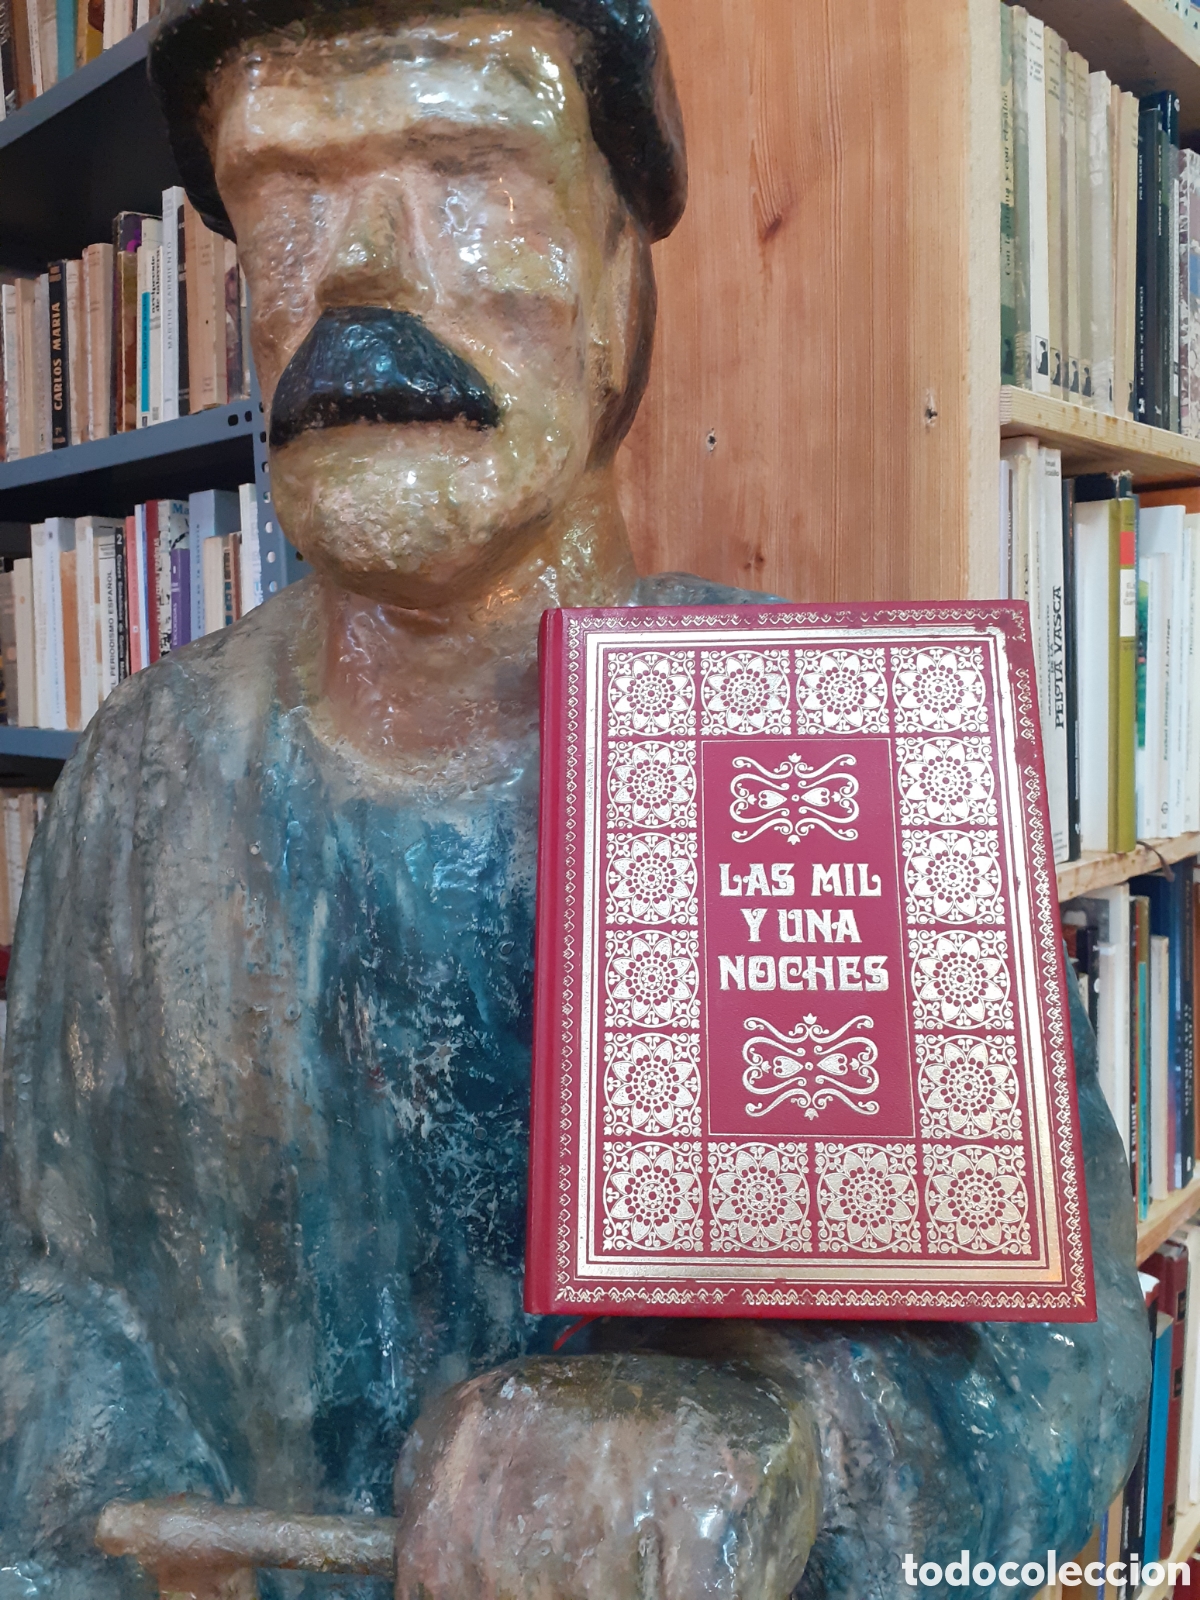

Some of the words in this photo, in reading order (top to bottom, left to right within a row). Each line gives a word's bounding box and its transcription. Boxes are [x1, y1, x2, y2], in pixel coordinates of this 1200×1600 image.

[51, 302, 62, 351] MARIA
[53, 358, 63, 411] CARLOS
[116, 533, 122, 545] 2
[109, 618, 117, 676] PERIODISMO
[1052, 585, 1063, 661] VASCA
[1054, 662, 1064, 730] PELOTA
[718, 863, 795, 897] LAS
[811, 863, 882, 897] MIL
[740, 908, 768, 942] Y
[777, 909, 862, 943] UNA
[717, 955, 889, 992] NOCHES
